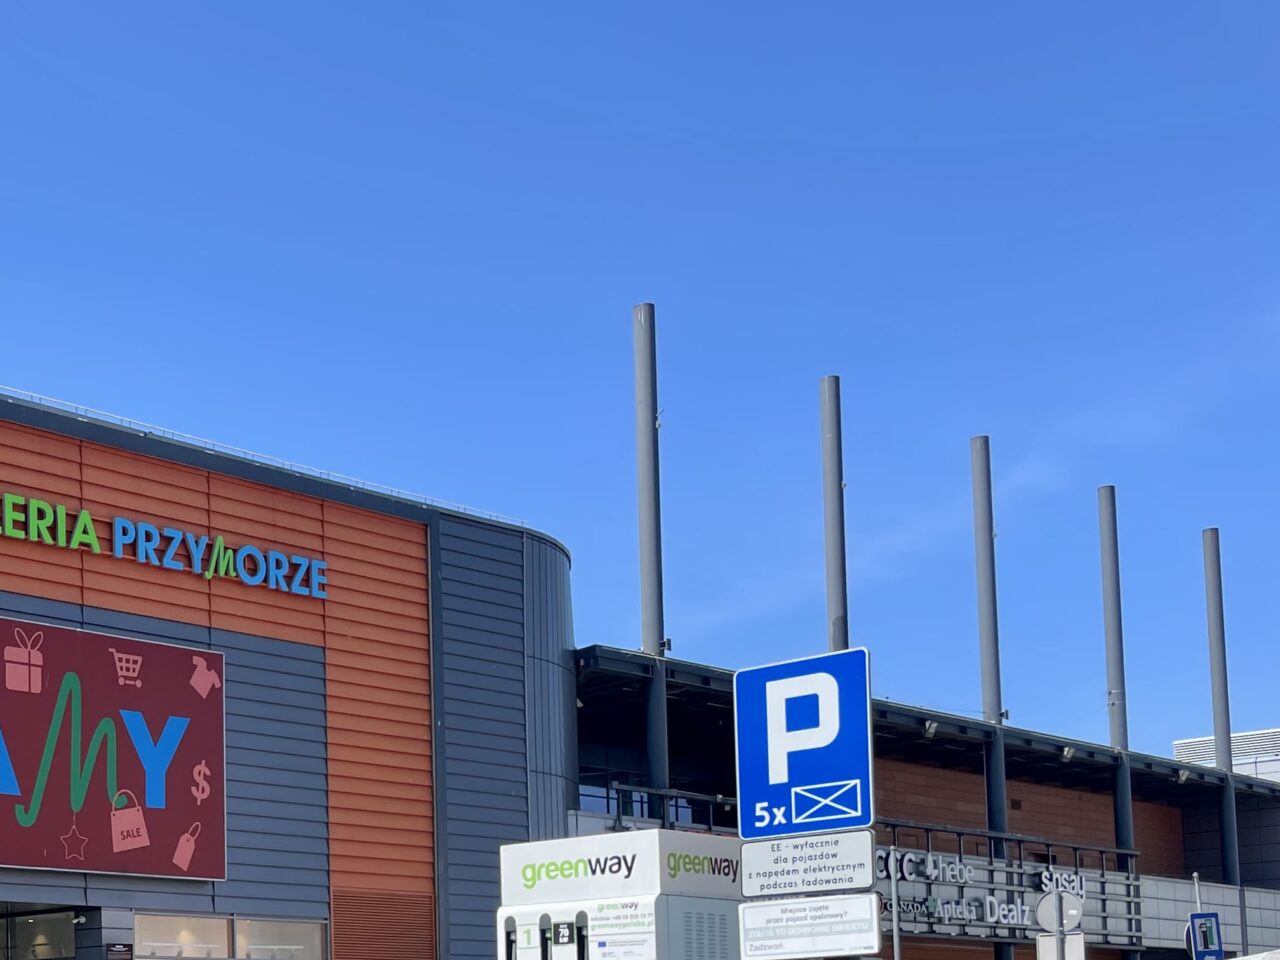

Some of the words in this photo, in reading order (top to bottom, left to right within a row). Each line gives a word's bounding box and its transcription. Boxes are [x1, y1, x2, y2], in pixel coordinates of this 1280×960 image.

[112, 516, 328, 599] PRZYMORZE
[766, 672, 840, 785] P
[754, 802, 787, 828] 5x
[119, 827, 142, 841] SALE
[771, 843, 782, 852] EE
[521, 852, 638, 889] greenway
[667, 851, 739, 884] greenway
[773, 856, 788, 864] dla
[803, 861, 866, 876] elektrycznym
[939, 855, 974, 884] hebe
[760, 881, 798, 892] podczas
[886, 901, 928, 913] CNADA
[934, 898, 977, 924] Apteka
[985, 896, 1031, 925] Dealz
[523, 928, 532, 945] 1
[558, 928, 569, 937] 70
